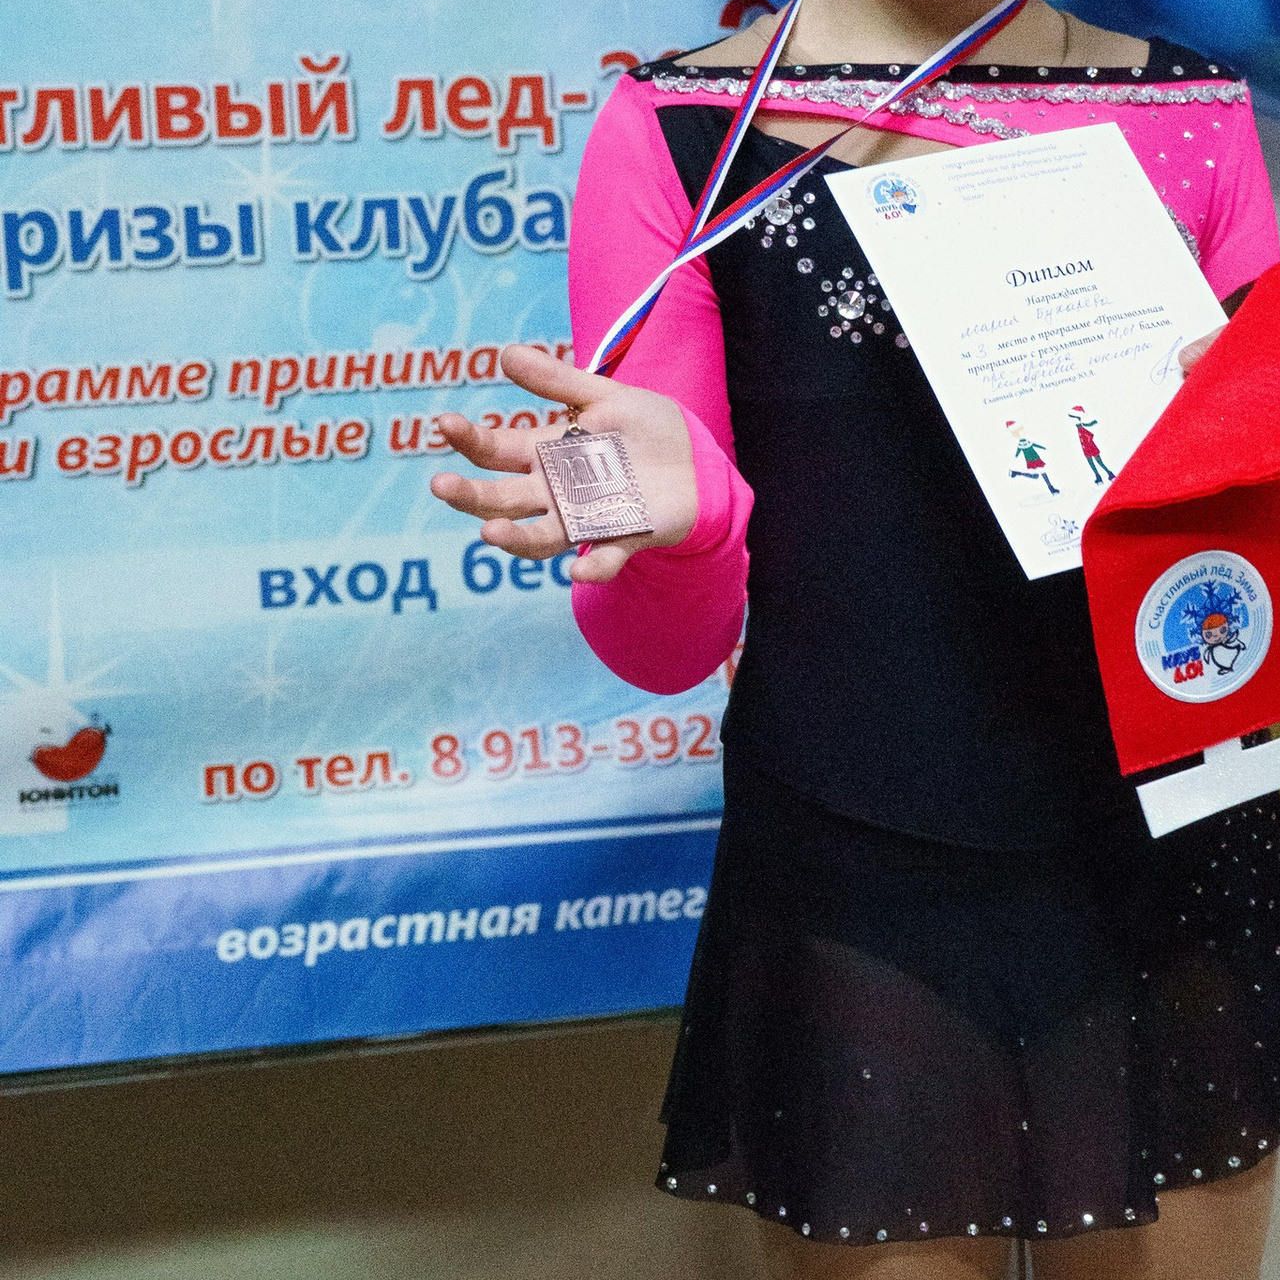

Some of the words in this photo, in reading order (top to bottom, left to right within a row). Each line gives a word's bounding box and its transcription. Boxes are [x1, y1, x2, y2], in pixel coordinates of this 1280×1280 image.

[384, 51, 640, 148] лед-
[2, 204, 256, 291] ризы
[294, 170, 568, 273] клуба
[1005, 259, 1095, 287] Диплом
[1025, 283, 1098, 307] Награждается
[997, 336, 1029, 350] место
[1038, 319, 1091, 341] программе
[1038, 333, 1104, 360] результатом
[0, 361, 207, 421] рамме
[228, 344, 573, 406] принима
[0, 439, 29, 474] и
[56, 421, 365, 482] взрослые
[258, 559, 438, 614] вход
[461, 539, 579, 595] бес
[1148, 565, 1208, 630] Счастливый
[1235, 571, 1258, 602] Зима
[1161, 646, 1201, 671] КЛУБ
[204, 761, 275, 797] по
[296, 750, 410, 789] тел.
[430, 733, 463, 778] 8
[482, 714, 715, 774] 913-392
[216, 903, 542, 967] возрастная
[555, 886, 708, 931] катег
